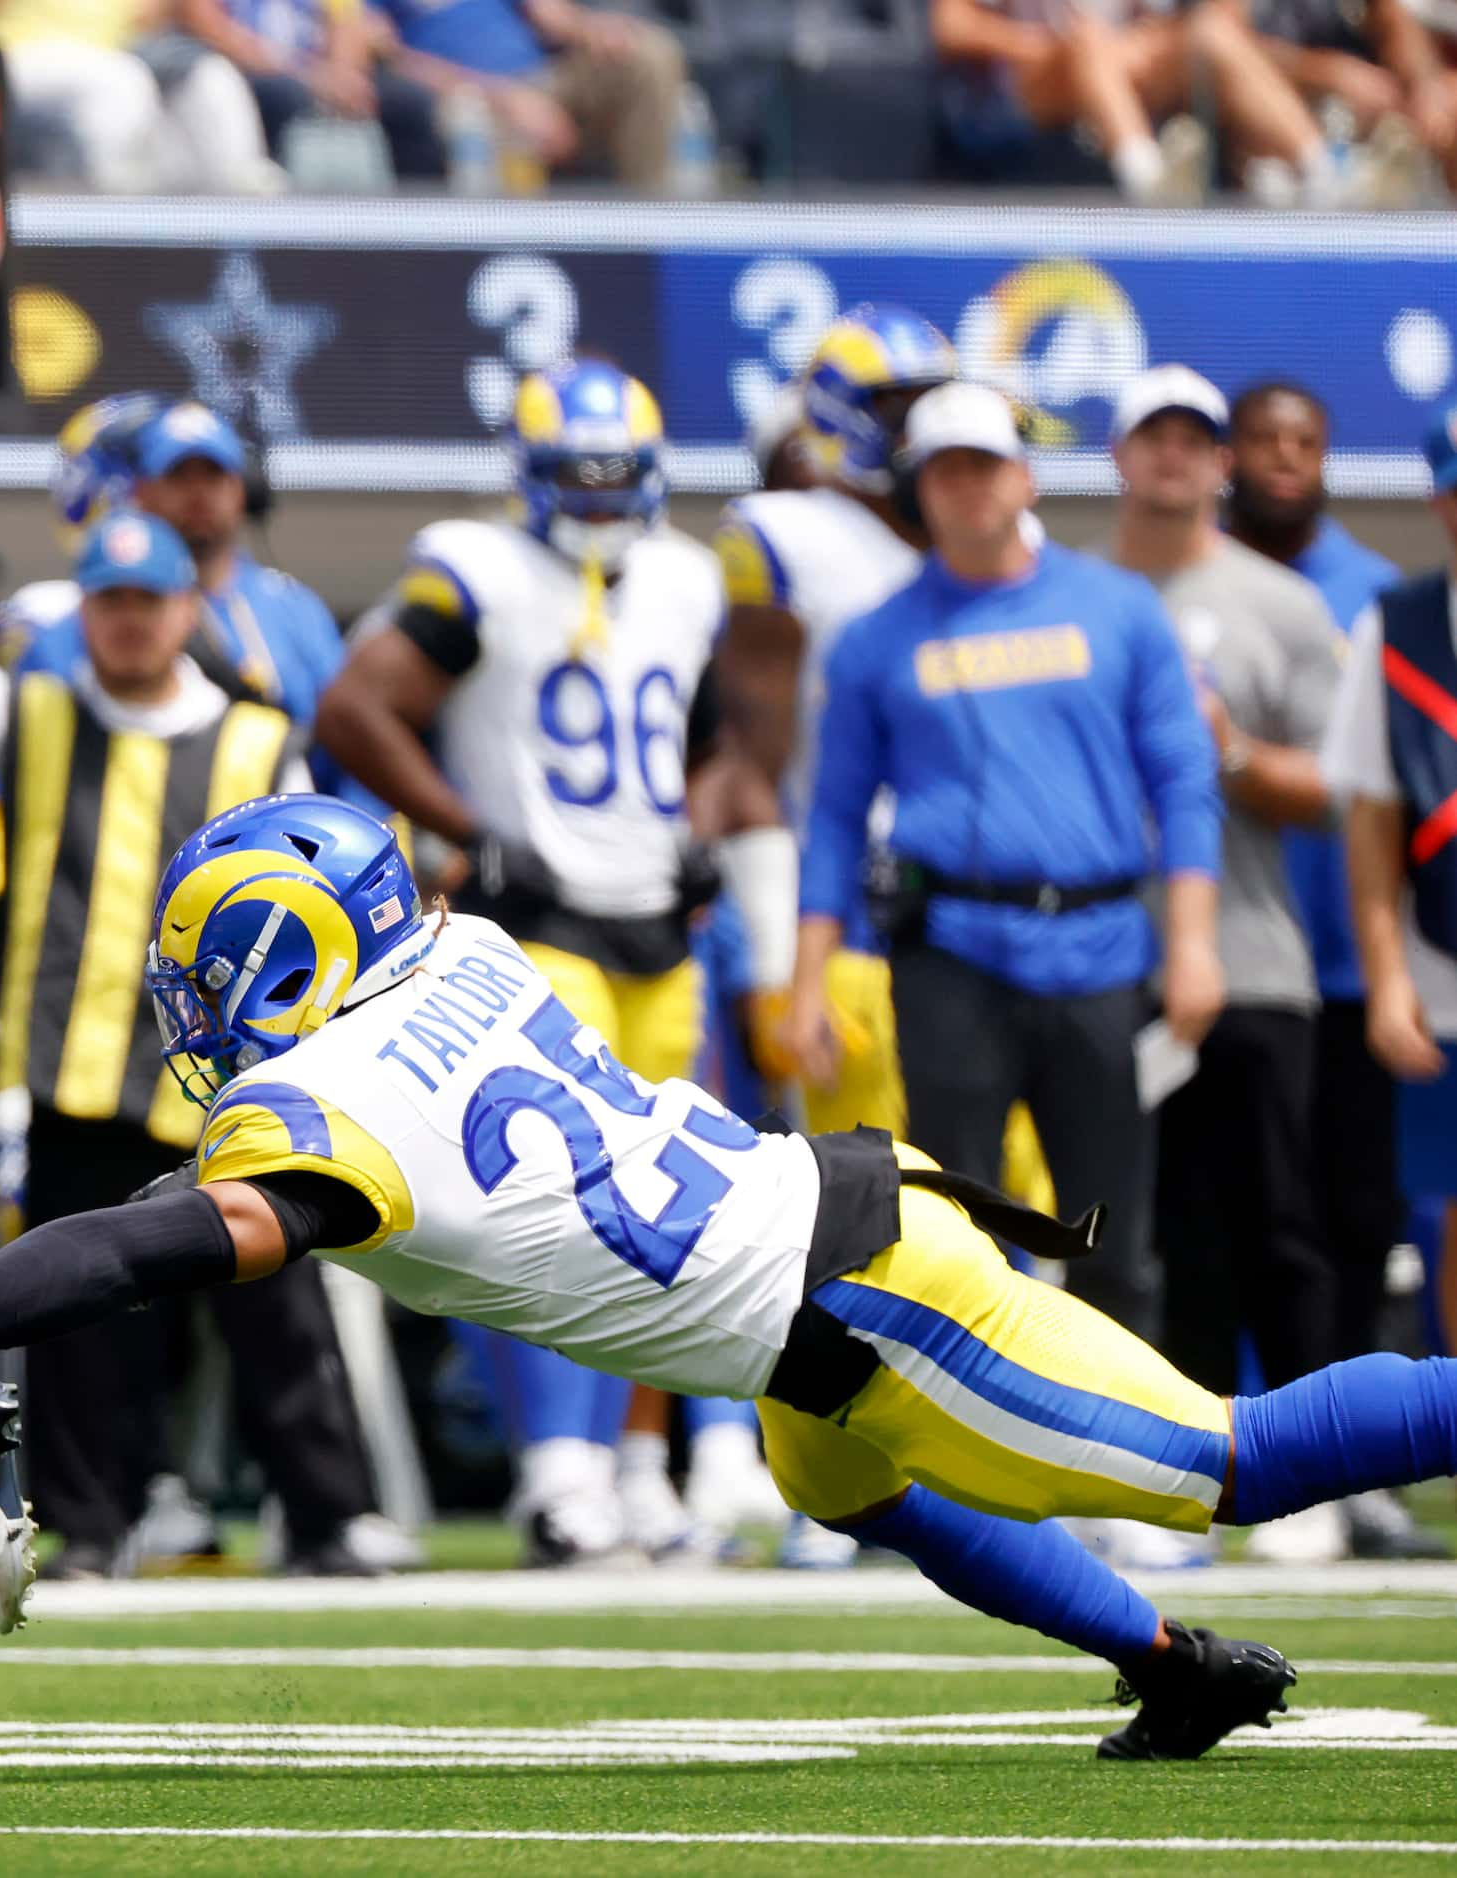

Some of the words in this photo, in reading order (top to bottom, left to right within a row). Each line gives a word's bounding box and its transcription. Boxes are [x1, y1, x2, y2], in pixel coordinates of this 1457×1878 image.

[539, 662, 685, 815] 96
[375, 956, 525, 1094] TAYLOR
[461, 991, 761, 1290] 25
